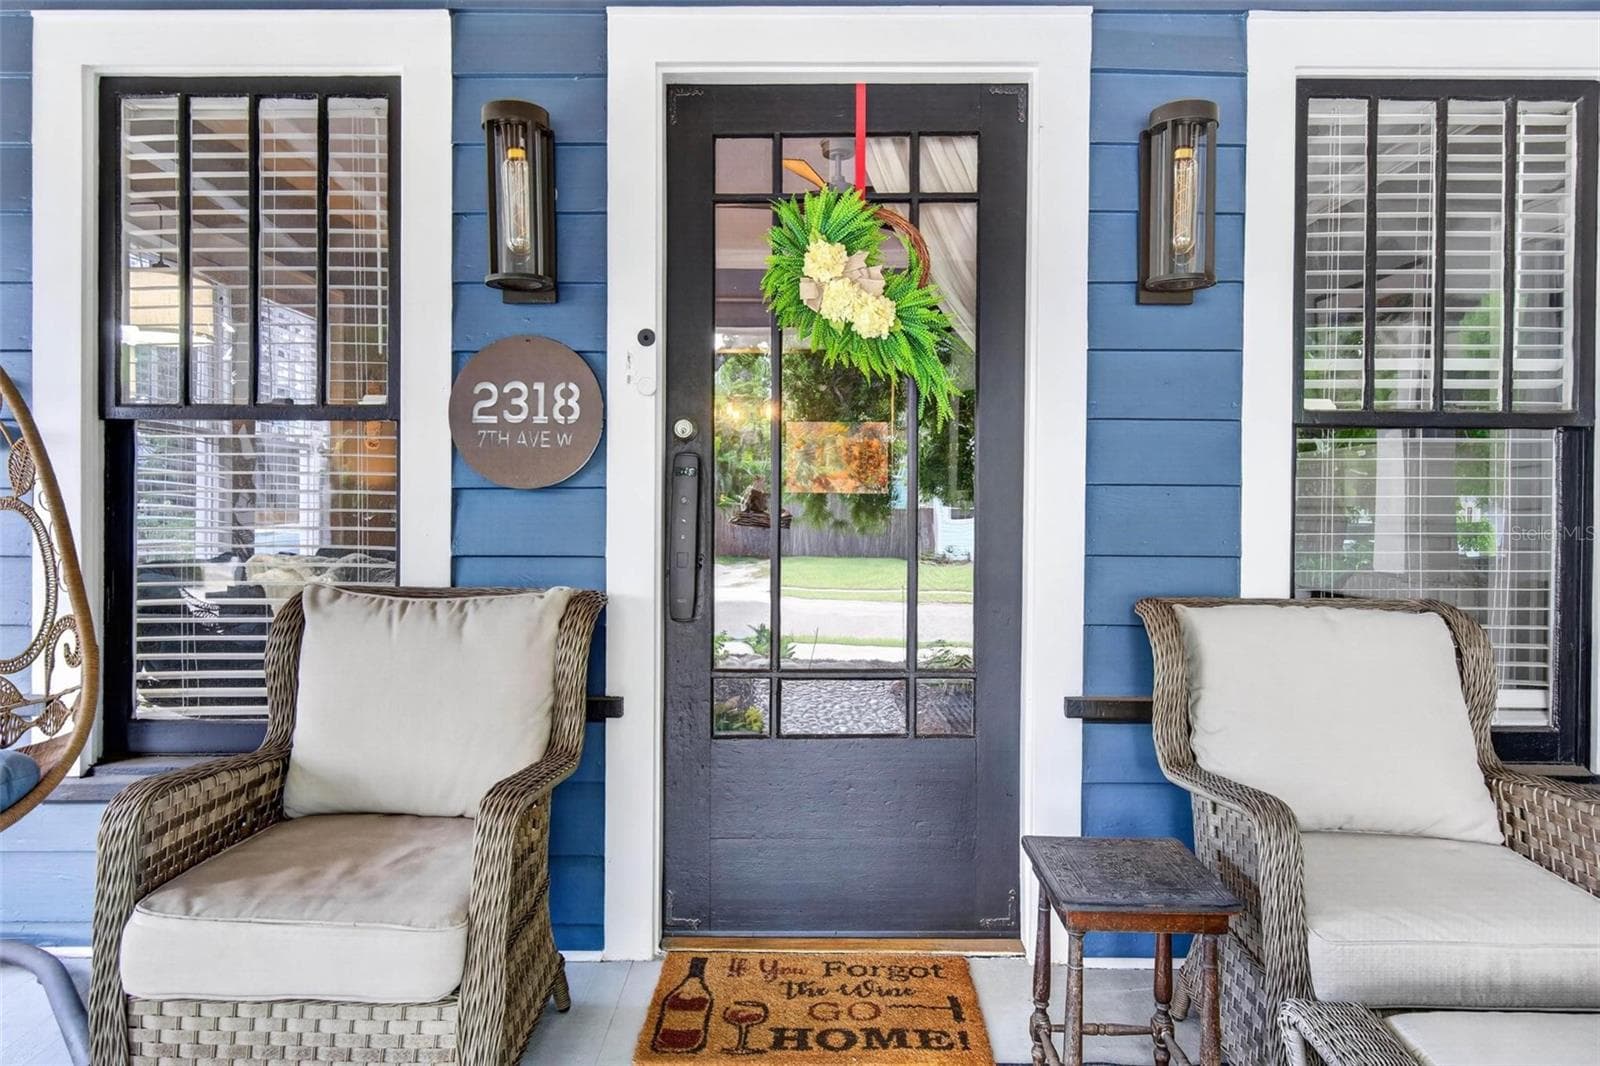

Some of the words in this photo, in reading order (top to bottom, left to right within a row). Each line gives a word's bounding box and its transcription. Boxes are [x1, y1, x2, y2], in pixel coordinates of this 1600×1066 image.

[472, 380, 581, 425] 2318
[478, 430, 510, 448] 7TH
[516, 430, 551, 448] AVE
[557, 432, 573, 446] W
[727, 957, 747, 977] If
[759, 958, 808, 982] You
[822, 960, 946, 982] Forgot
[779, 979, 829, 1000] The
[836, 979, 916, 999] Wine
[807, 1001, 882, 1021] GO
[768, 1026, 972, 1051] HOME!
